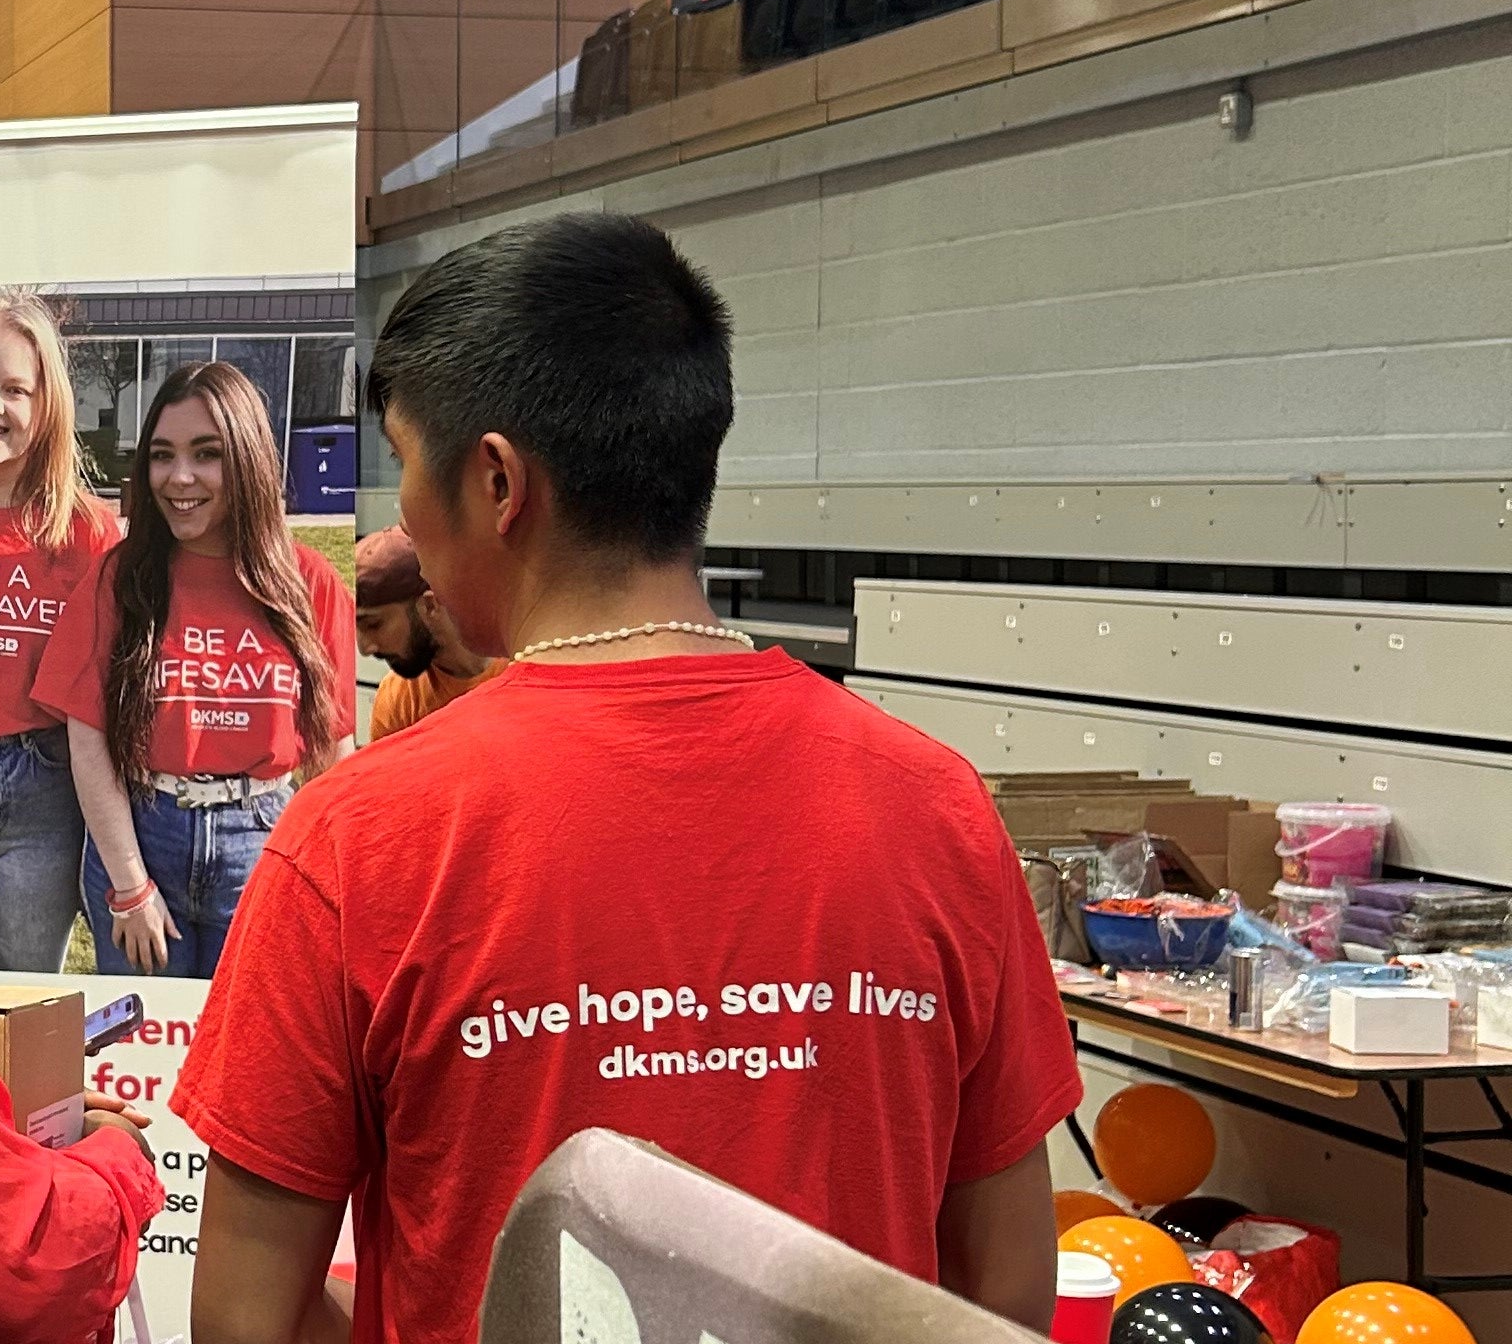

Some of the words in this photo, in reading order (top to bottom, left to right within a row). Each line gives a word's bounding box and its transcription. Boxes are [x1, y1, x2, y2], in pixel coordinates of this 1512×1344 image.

[8, 564, 31, 590] A
[184, 627, 226, 656] BE
[236, 628, 263, 654] A
[191, 709, 235, 725] DKMS
[461, 999, 570, 1058] give
[578, 984, 709, 1031] hope,
[720, 978, 834, 1016] save
[848, 971, 937, 1022] lives
[116, 1014, 200, 1047] en
[598, 1037, 819, 1080] dkms.org.uk
[91, 1061, 162, 1101] for
[162, 1151, 181, 1170] a
